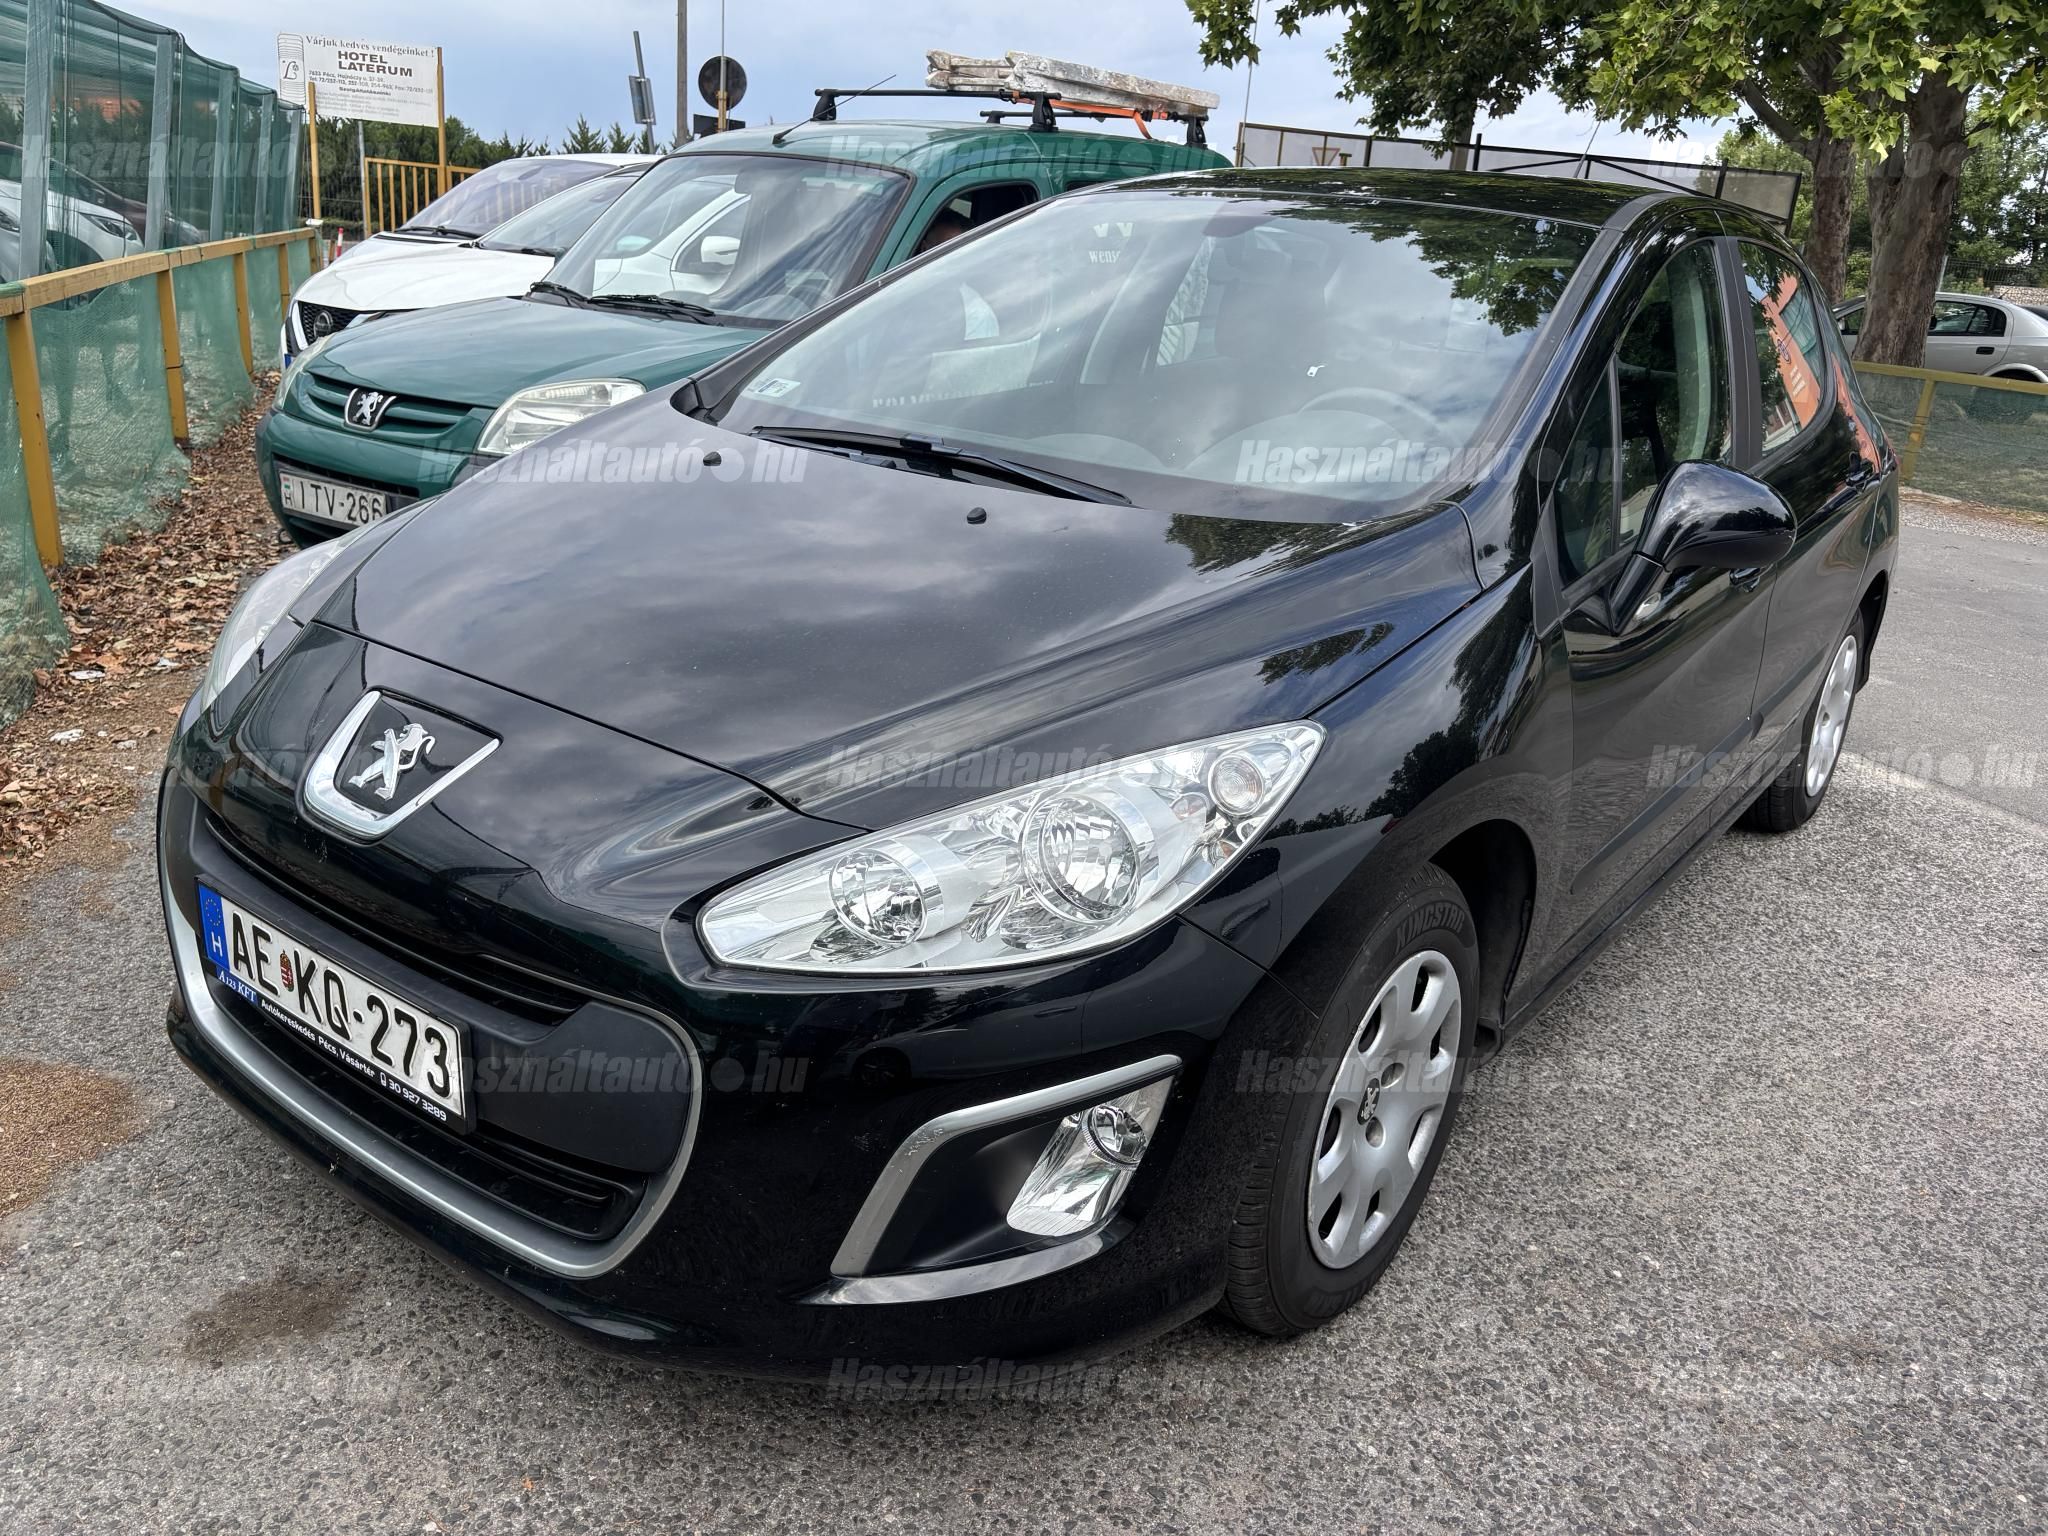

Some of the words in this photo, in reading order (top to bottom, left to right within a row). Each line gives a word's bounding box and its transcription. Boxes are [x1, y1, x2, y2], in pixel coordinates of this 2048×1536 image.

[306, 35, 337, 47] Várjuk
[340, 39, 369, 50] kedves
[371, 42, 429, 57] vendégeinket
[337, 50, 388, 64] HOTEL
[338, 60, 413, 77] LATERUM
[300, 481, 383, 524] ITV-266
[211, 931, 224, 957] H
[232, 910, 280, 997] AE
[237, 978, 257, 1003] KFT
[261, 999, 316, 1041] Autókereskedés
[339, 1048, 375, 1079] Vásártér
[388, 1077, 401, 1094] 30
[402, 1083, 420, 1105] 927
[421, 1094, 448, 1122] 3289
